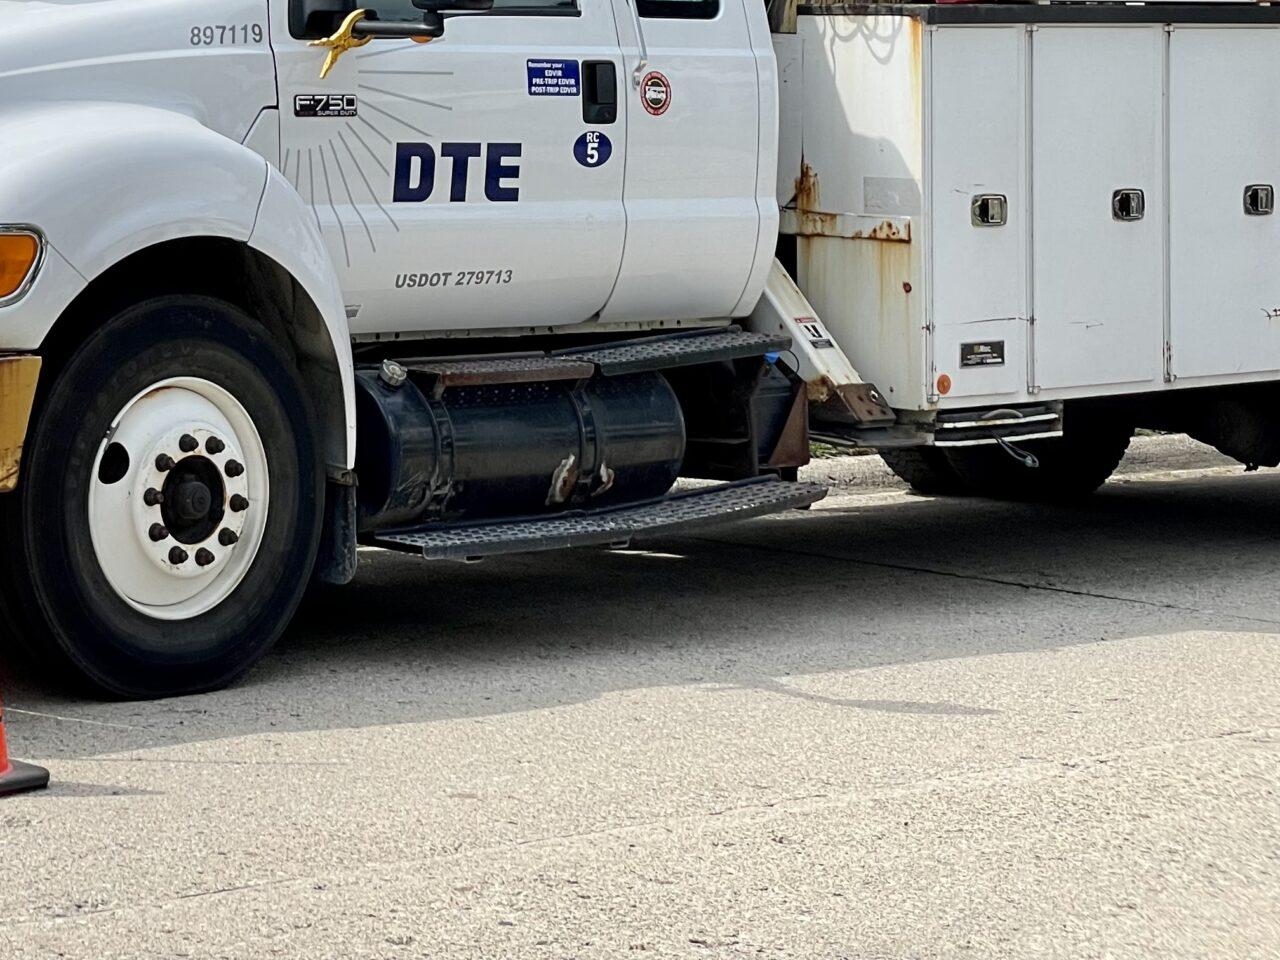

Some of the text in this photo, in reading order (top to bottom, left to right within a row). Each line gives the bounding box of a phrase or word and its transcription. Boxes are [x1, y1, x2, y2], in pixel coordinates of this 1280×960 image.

[190, 23, 263, 46] 897119
[586, 132, 600, 143] RC
[586, 142, 599, 164] 5
[392, 142, 522, 202] DTE
[395, 269, 513, 288] USDOT 279713
